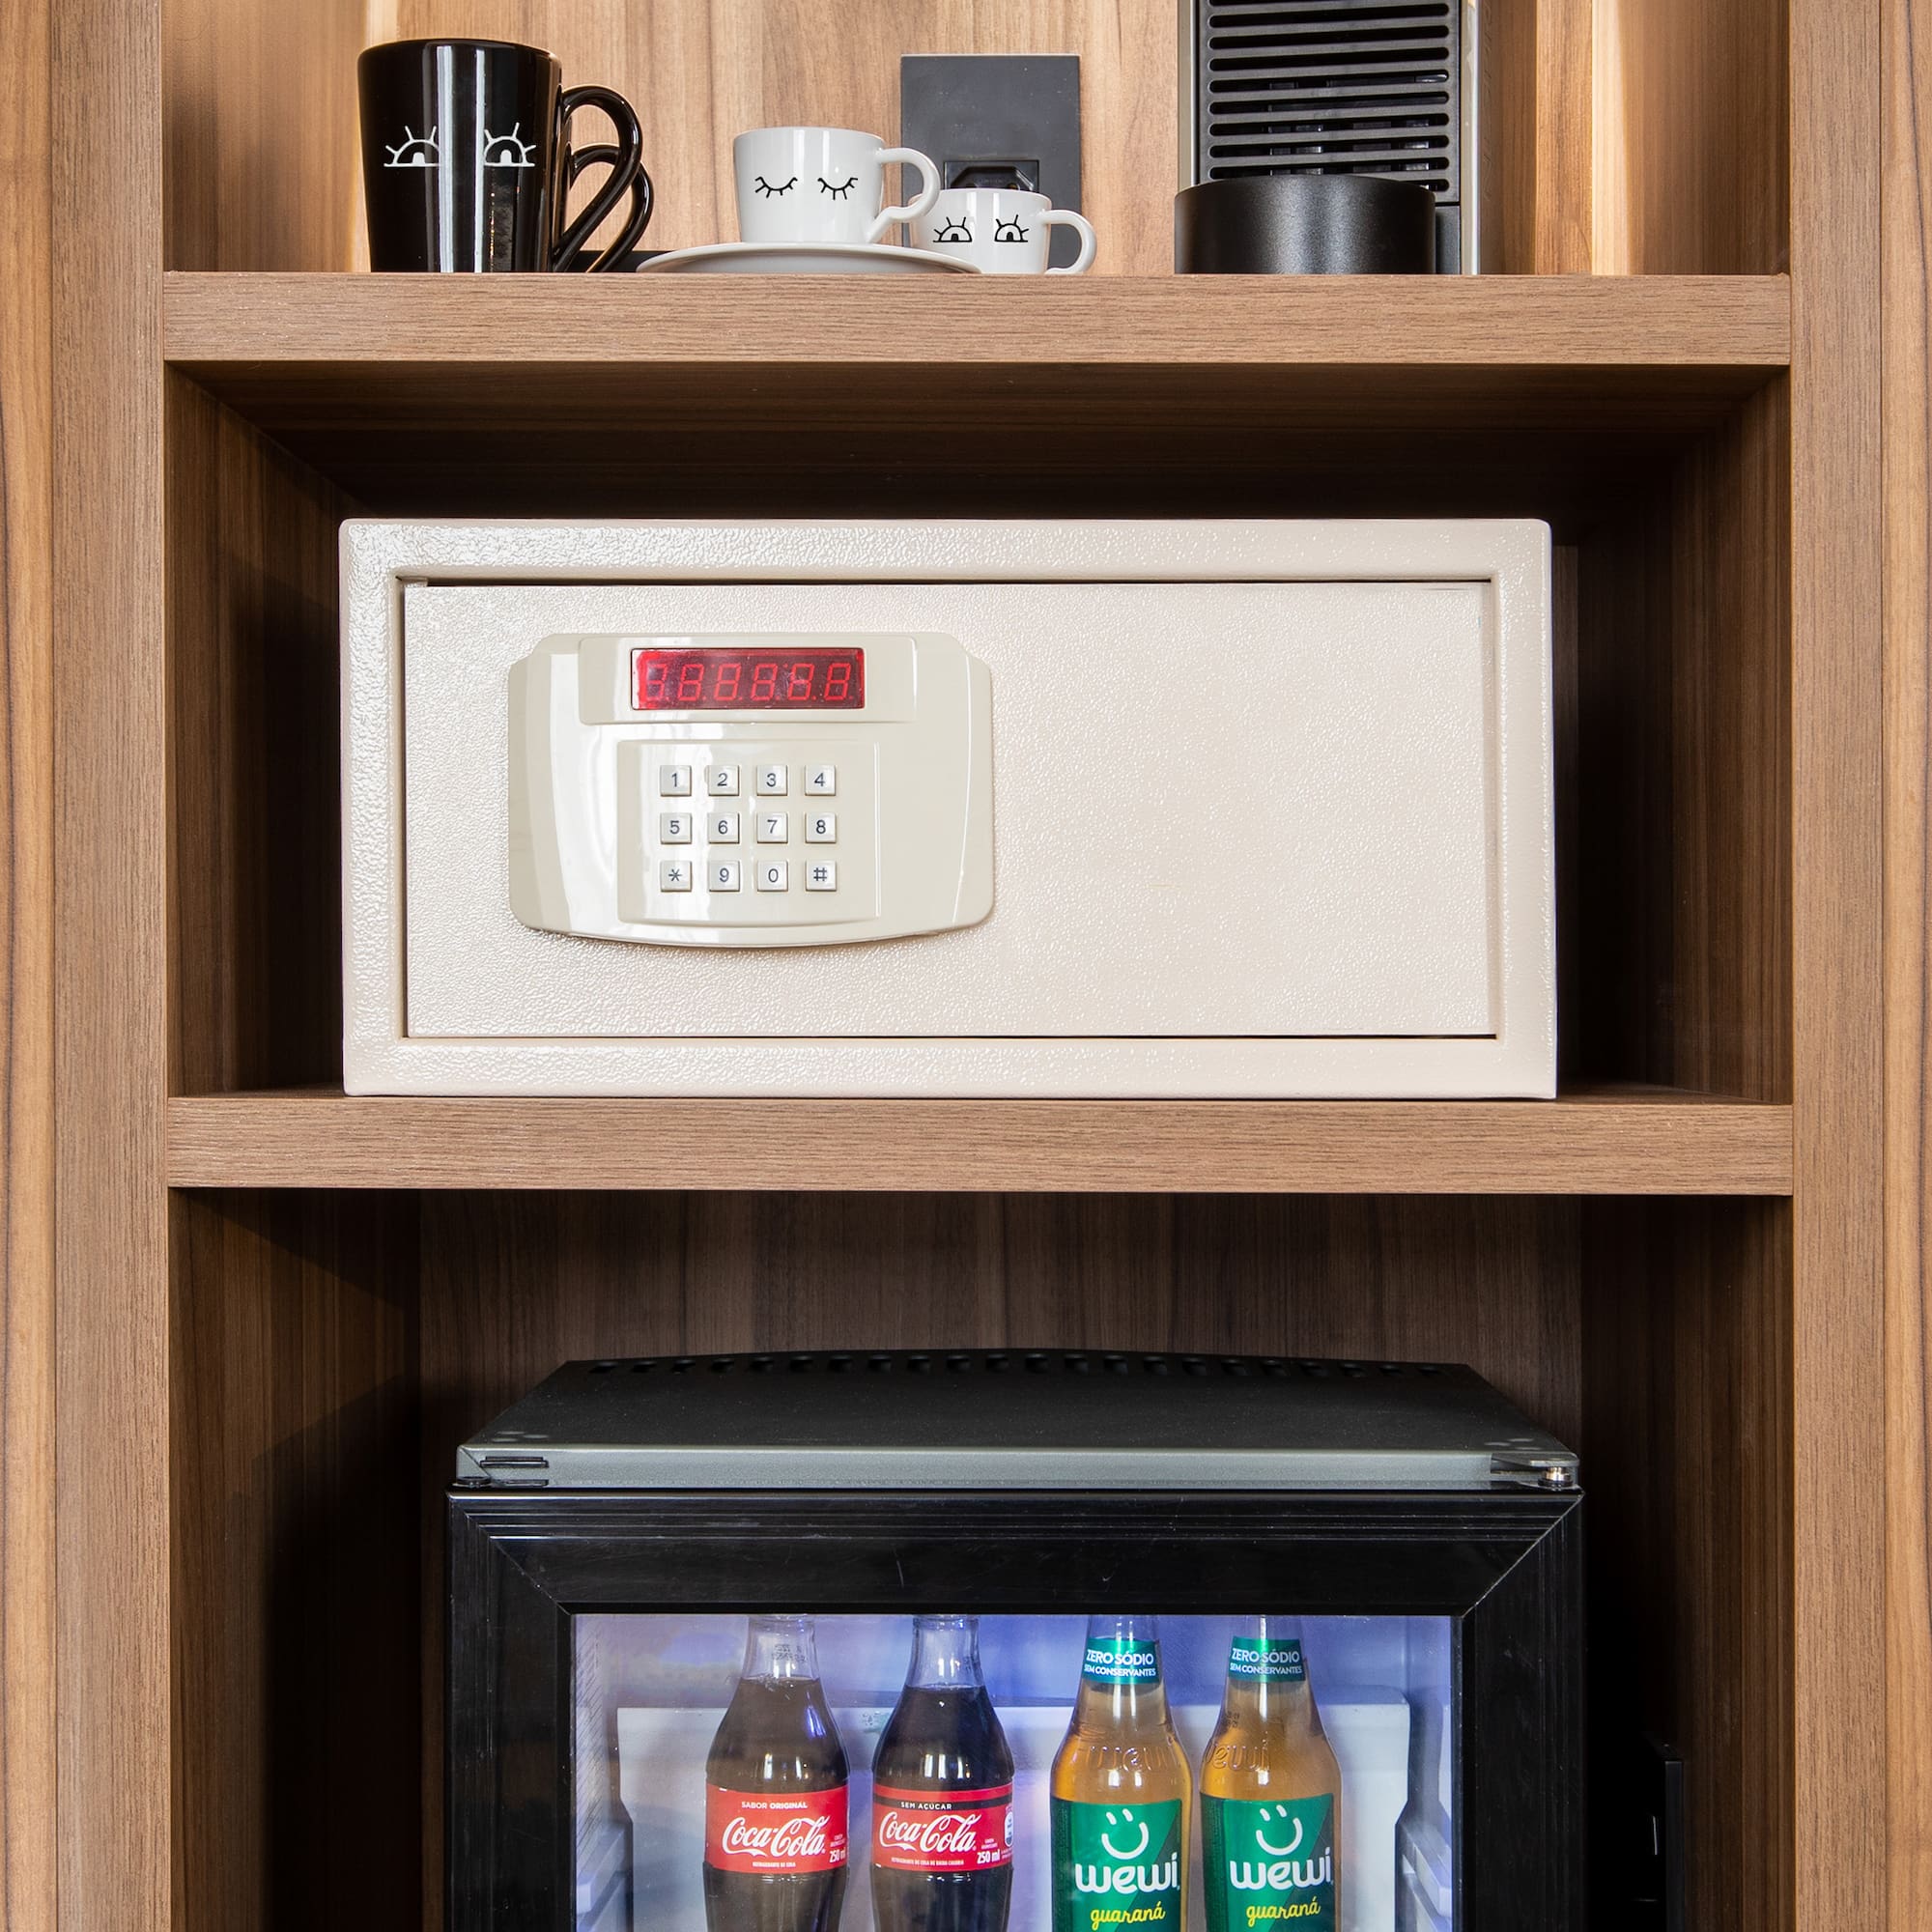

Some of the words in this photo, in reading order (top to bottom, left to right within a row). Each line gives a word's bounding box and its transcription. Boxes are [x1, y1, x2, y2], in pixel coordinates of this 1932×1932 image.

[671, 772, 678, 787] 1
[717, 772, 728, 787] 2
[766, 772, 777, 787] 3
[813, 772, 825, 787] 4
[669, 819, 680, 835] 5
[718, 819, 728, 835] 6
[766, 818, 778, 834] 7
[815, 819, 827, 835] 8
[719, 867, 729, 883] 9
[1086, 1649, 1114, 1664] ZERO
[1115, 1650, 1154, 1665] SÓDIO
[1231, 1647, 1260, 1662] ZERO
[1261, 1649, 1300, 1663] SÓDIO
[1084, 1663, 1095, 1674] SEM
[1095, 1666, 1156, 1677] CONSERVANTES
[1230, 1662, 1241, 1672] SEM
[1241, 1664, 1302, 1675] CONSERVANTES
[741, 1801, 768, 1809] SABOR
[769, 1801, 809, 1809] ORIGINAL
[900, 1801, 916, 1809] SEM
[722, 1815, 831, 1858] Coca-Cola
[879, 1811, 982, 1854] Coca-Cola
[977, 1850, 990, 1864] 250
[991, 1848, 1001, 1862] ml
[1074, 1852, 1178, 1894] wewi
[1229, 1846, 1331, 1890] wewi
[1090, 1900, 1166, 1931] guaraná
[1245, 1895, 1321, 1928] guaraná
